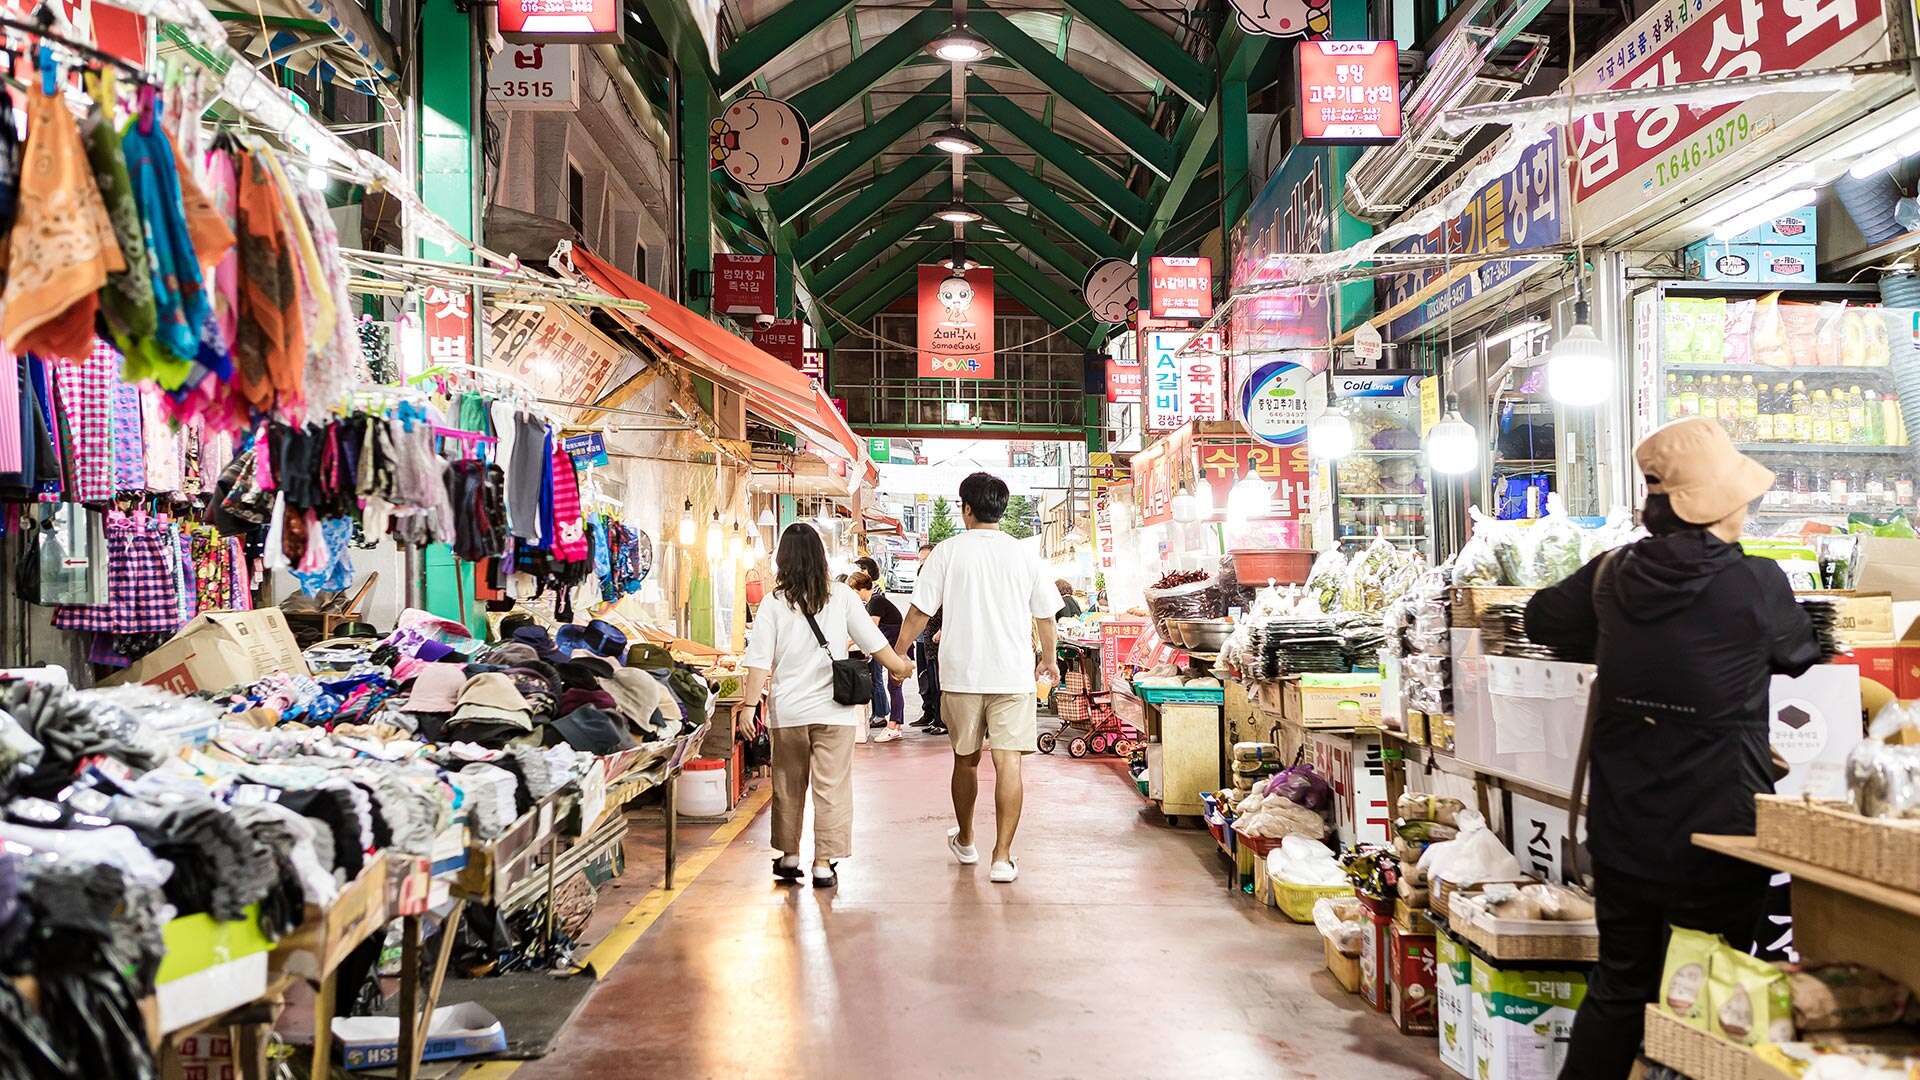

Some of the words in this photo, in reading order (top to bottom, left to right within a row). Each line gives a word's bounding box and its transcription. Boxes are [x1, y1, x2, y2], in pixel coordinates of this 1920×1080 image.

[1655, 112, 1749, 187] T.646-1379
[723, 269, 765, 280] 범화청과
[729, 281, 760, 292] 즉석김
[760, 334, 796, 345] 시민푸드
[933, 327, 977, 341] 소매각시
[931, 341, 981, 352] SomaeGaksi
[1344, 380, 1373, 391] Cold
[1504, 1004, 1539, 1016] Griwell
